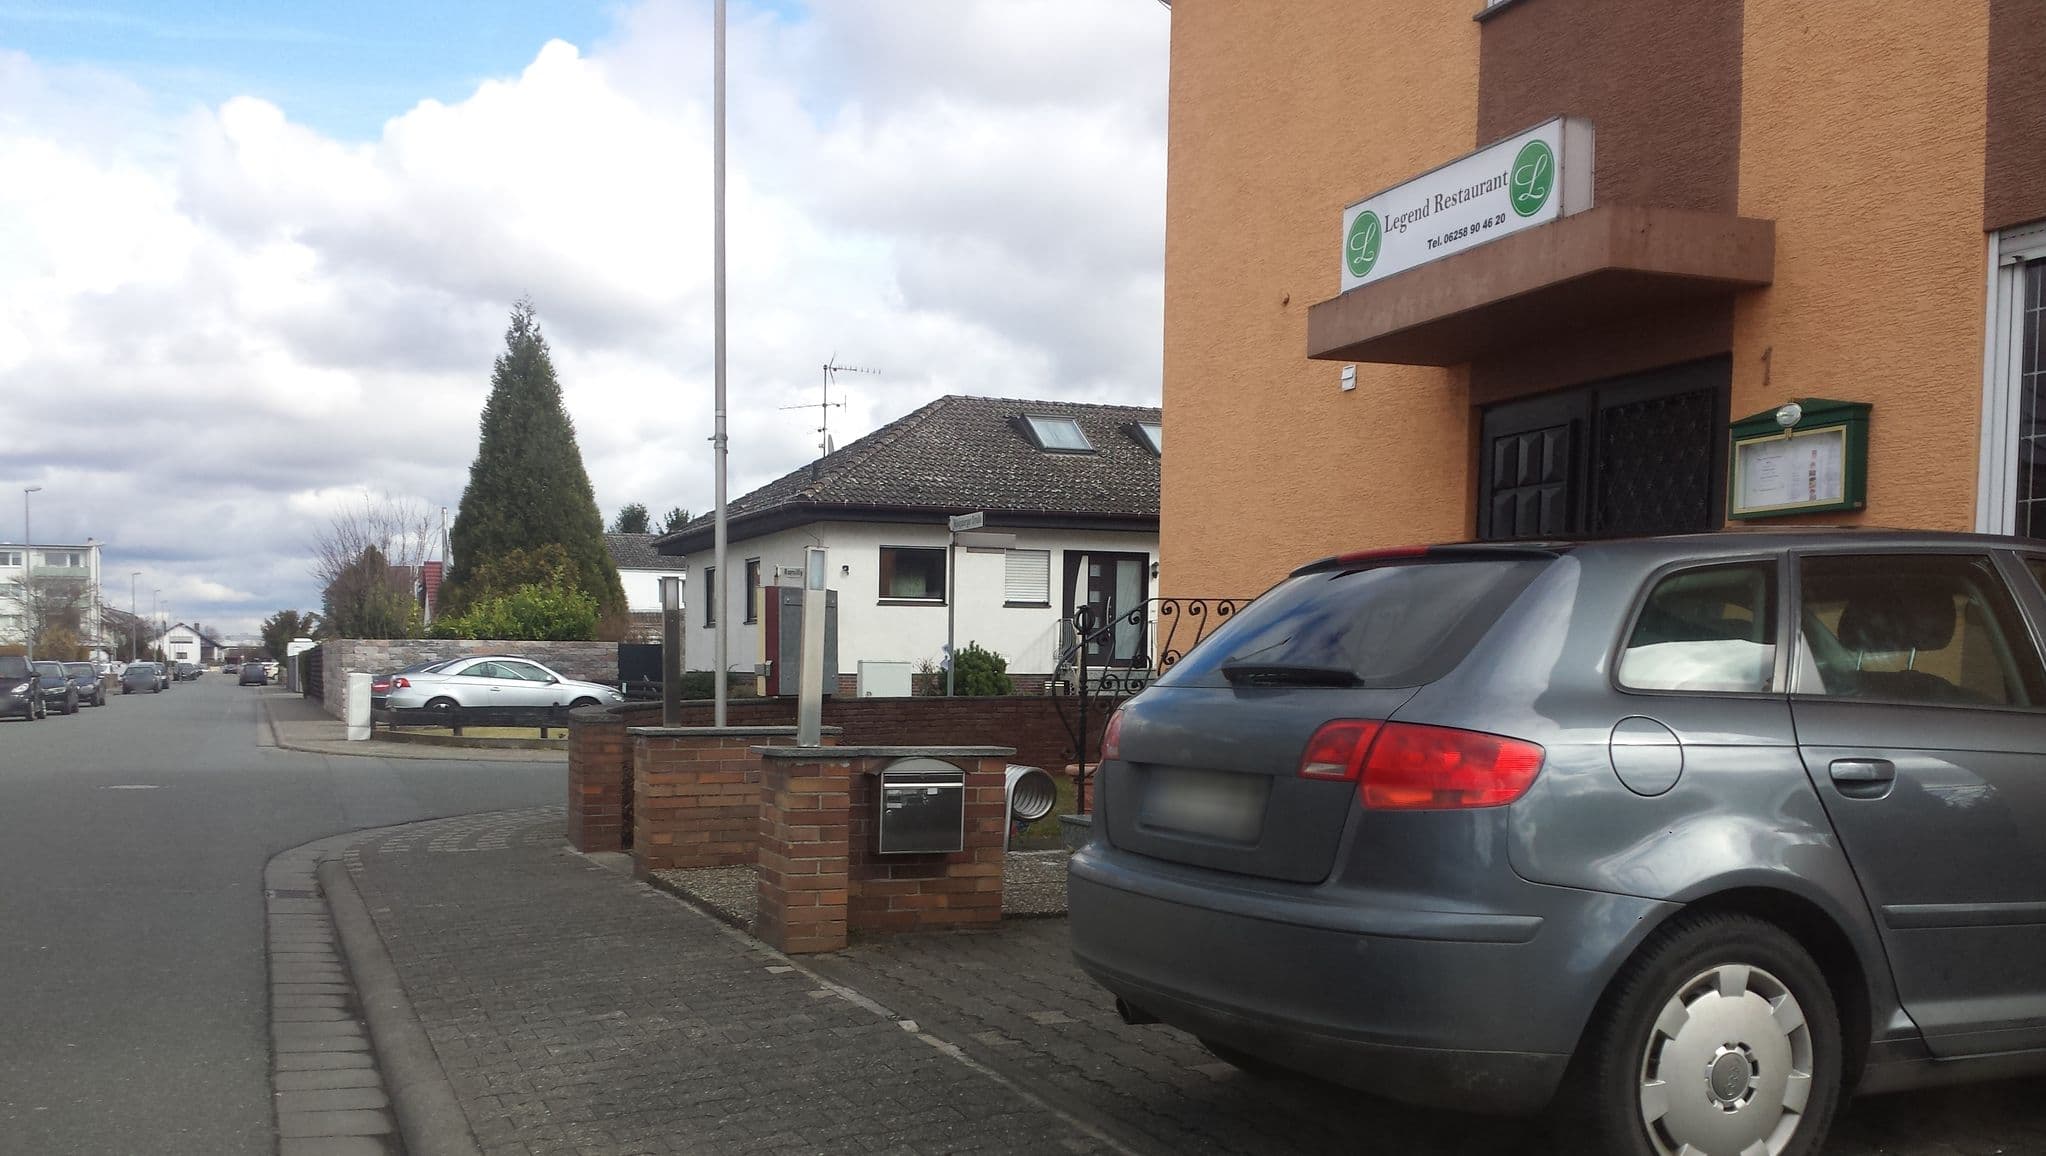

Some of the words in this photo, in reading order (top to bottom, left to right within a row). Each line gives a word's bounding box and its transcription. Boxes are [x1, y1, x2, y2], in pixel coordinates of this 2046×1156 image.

[1384, 198, 1430, 233] Legend
[1434, 170, 1509, 214] Restaurant
[1427, 236, 1442, 250] Tel.
[1443, 227, 1468, 243] 06258
[1470, 222, 1480, 234] 90
[1482, 217, 1493, 230] 46
[1495, 213, 1506, 226] 20
